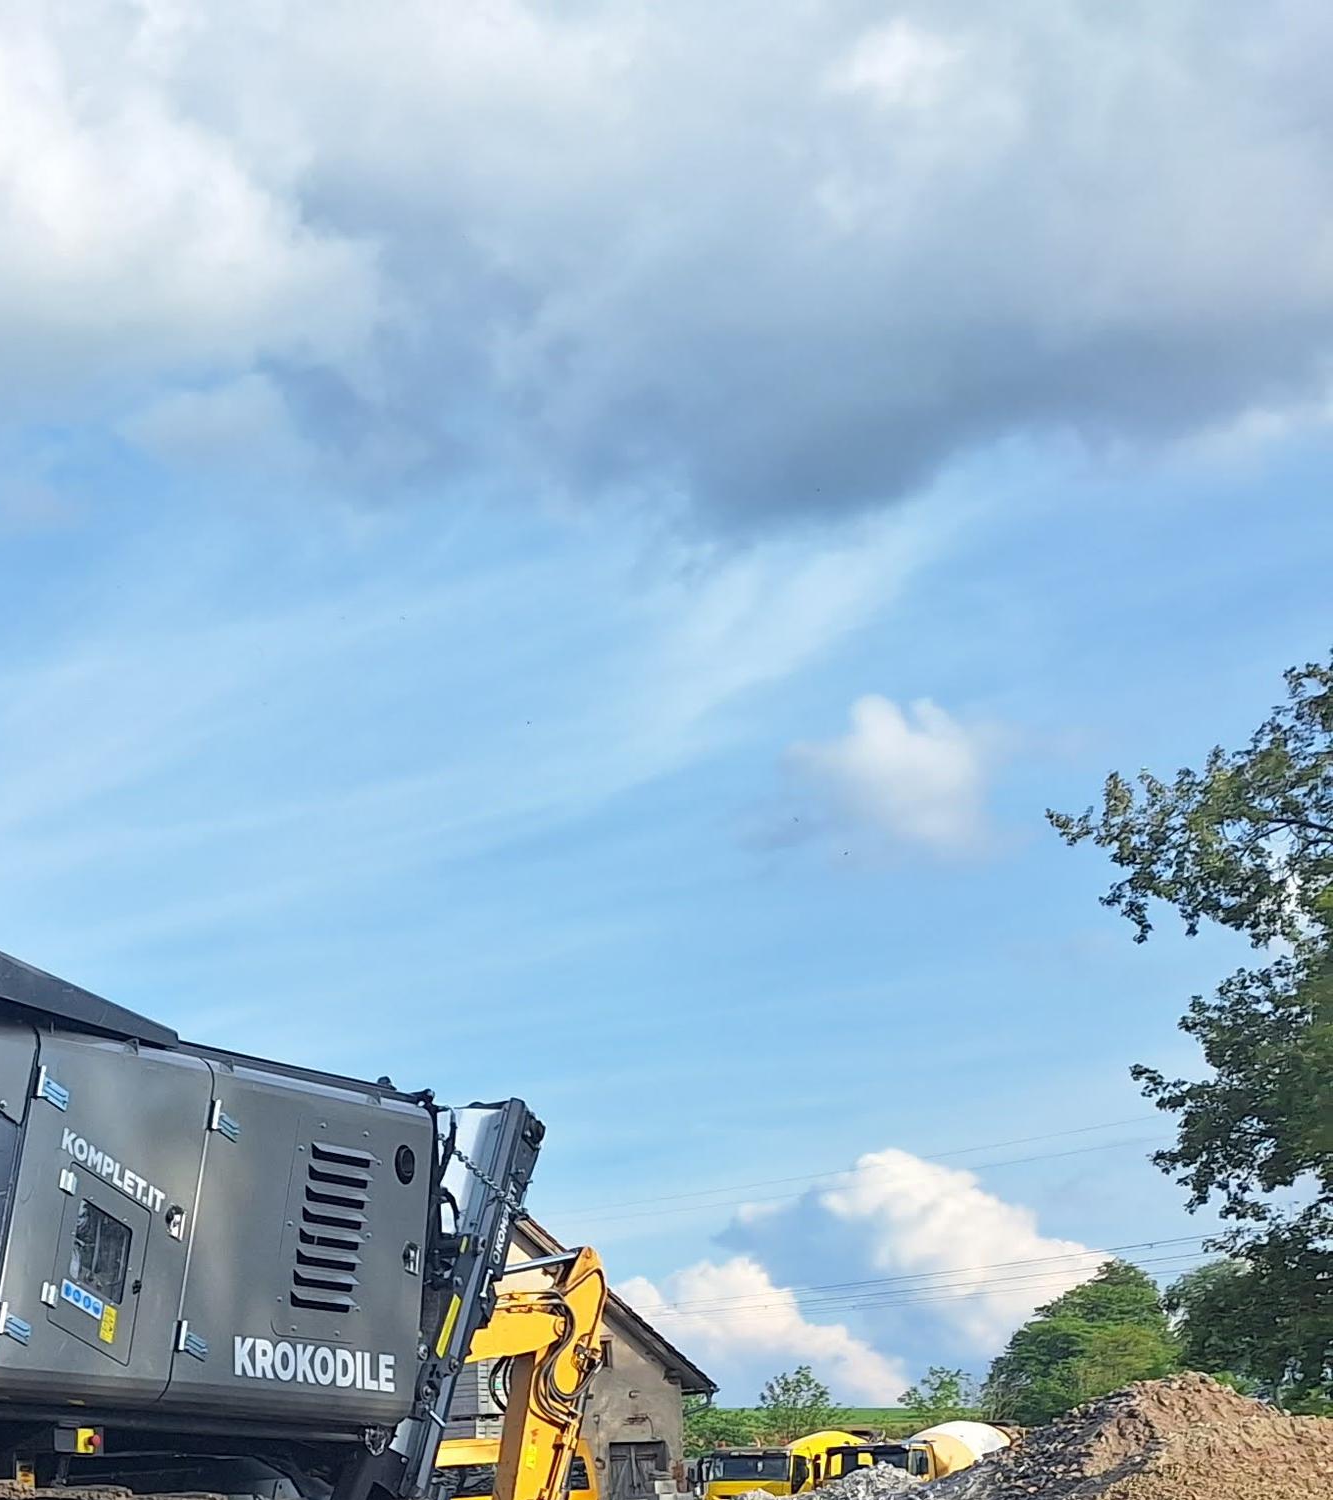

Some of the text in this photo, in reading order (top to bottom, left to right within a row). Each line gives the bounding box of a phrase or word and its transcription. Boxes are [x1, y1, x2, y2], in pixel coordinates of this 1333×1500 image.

[61, 1127, 166, 1213] KOMPLET.IT
[495, 1181, 517, 1253] KOMPLT
[234, 1335, 396, 1393] KROKODILE
